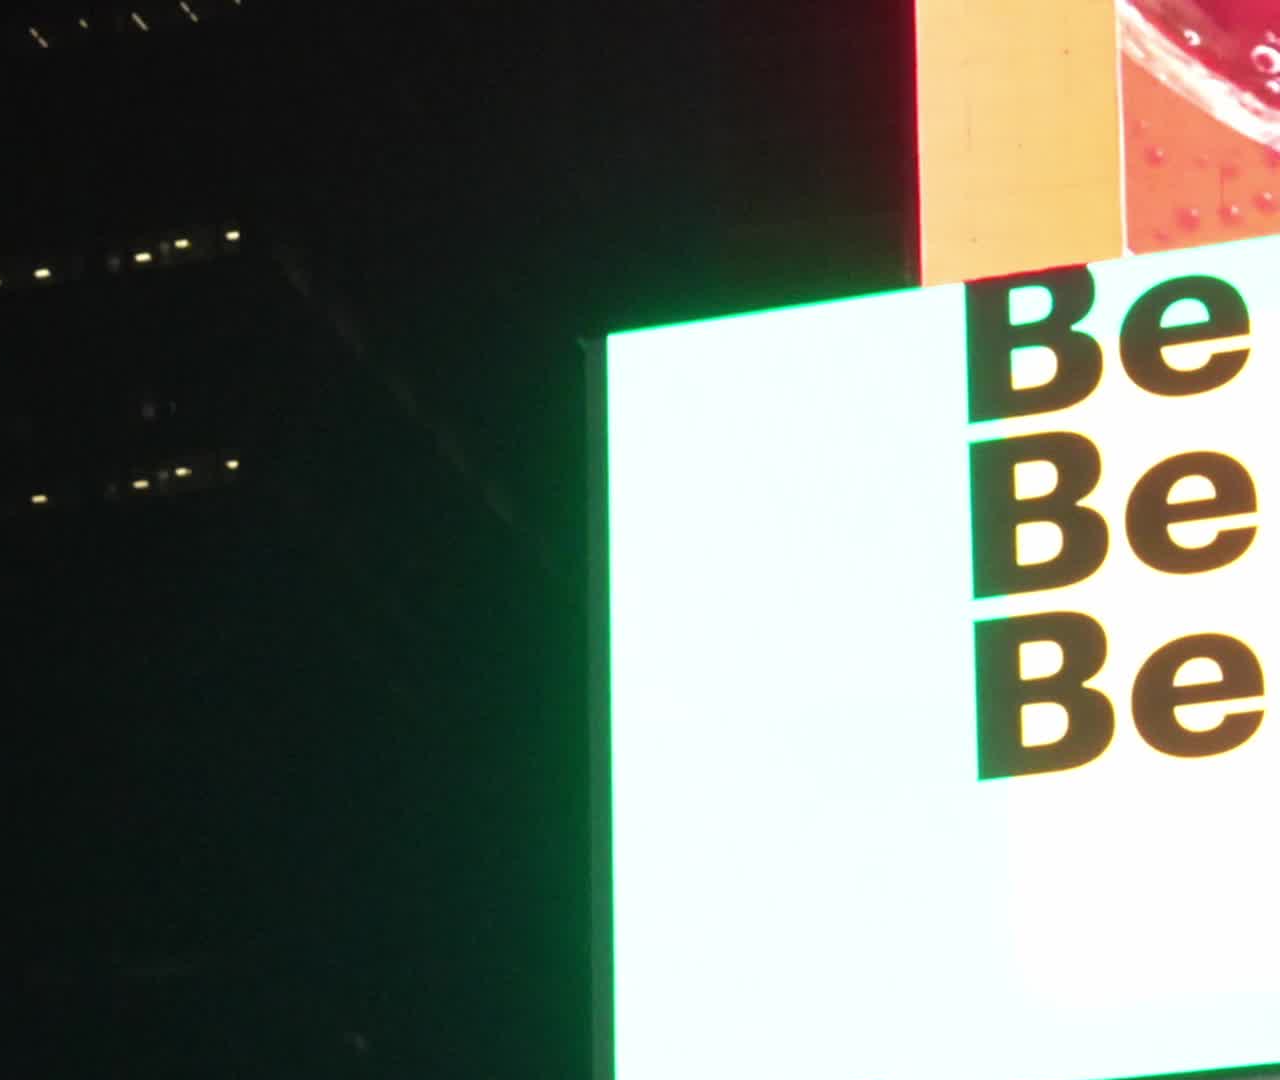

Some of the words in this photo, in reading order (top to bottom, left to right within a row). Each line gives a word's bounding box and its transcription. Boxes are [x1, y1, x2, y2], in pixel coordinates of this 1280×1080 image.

[965, 264, 1250, 423] Be
[968, 432, 1258, 599] Be
[973, 611, 1264, 781] Be
